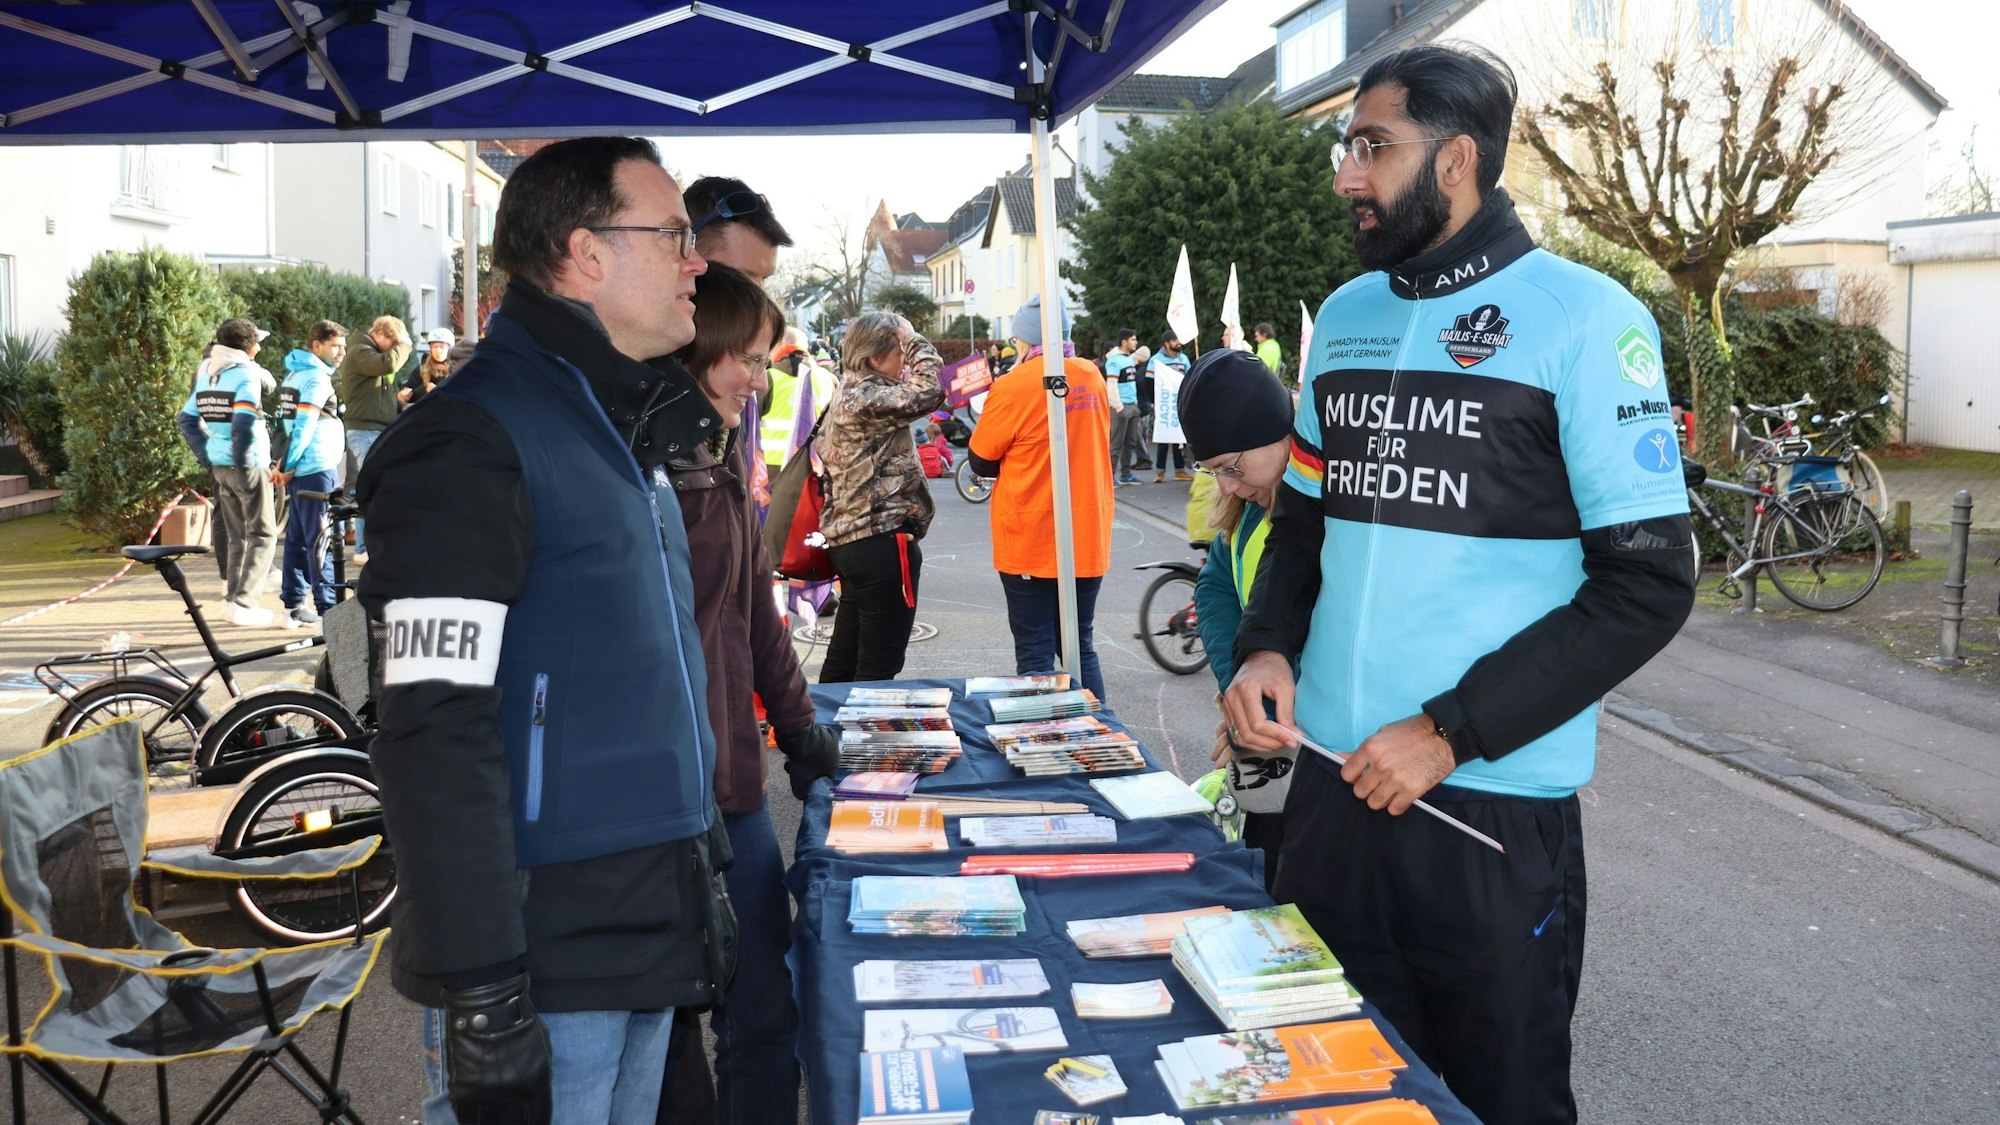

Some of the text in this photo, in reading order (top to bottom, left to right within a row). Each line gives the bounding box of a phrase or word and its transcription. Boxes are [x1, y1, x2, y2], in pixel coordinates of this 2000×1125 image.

[1434, 255, 1490, 289] AMJ
[1326, 336, 1400, 349] AHMADIYYA MUSLIM
[1438, 329, 1512, 348] MAJLIS-E-SEHAT
[1449, 345, 1492, 354] DEUTSCHLAND
[1326, 349, 1393, 361] JAMAAT GERMANY
[1325, 393, 1483, 438] MUSLIME
[1366, 431, 1407, 459] FÜR
[1327, 459, 1469, 509] FRIEDEN
